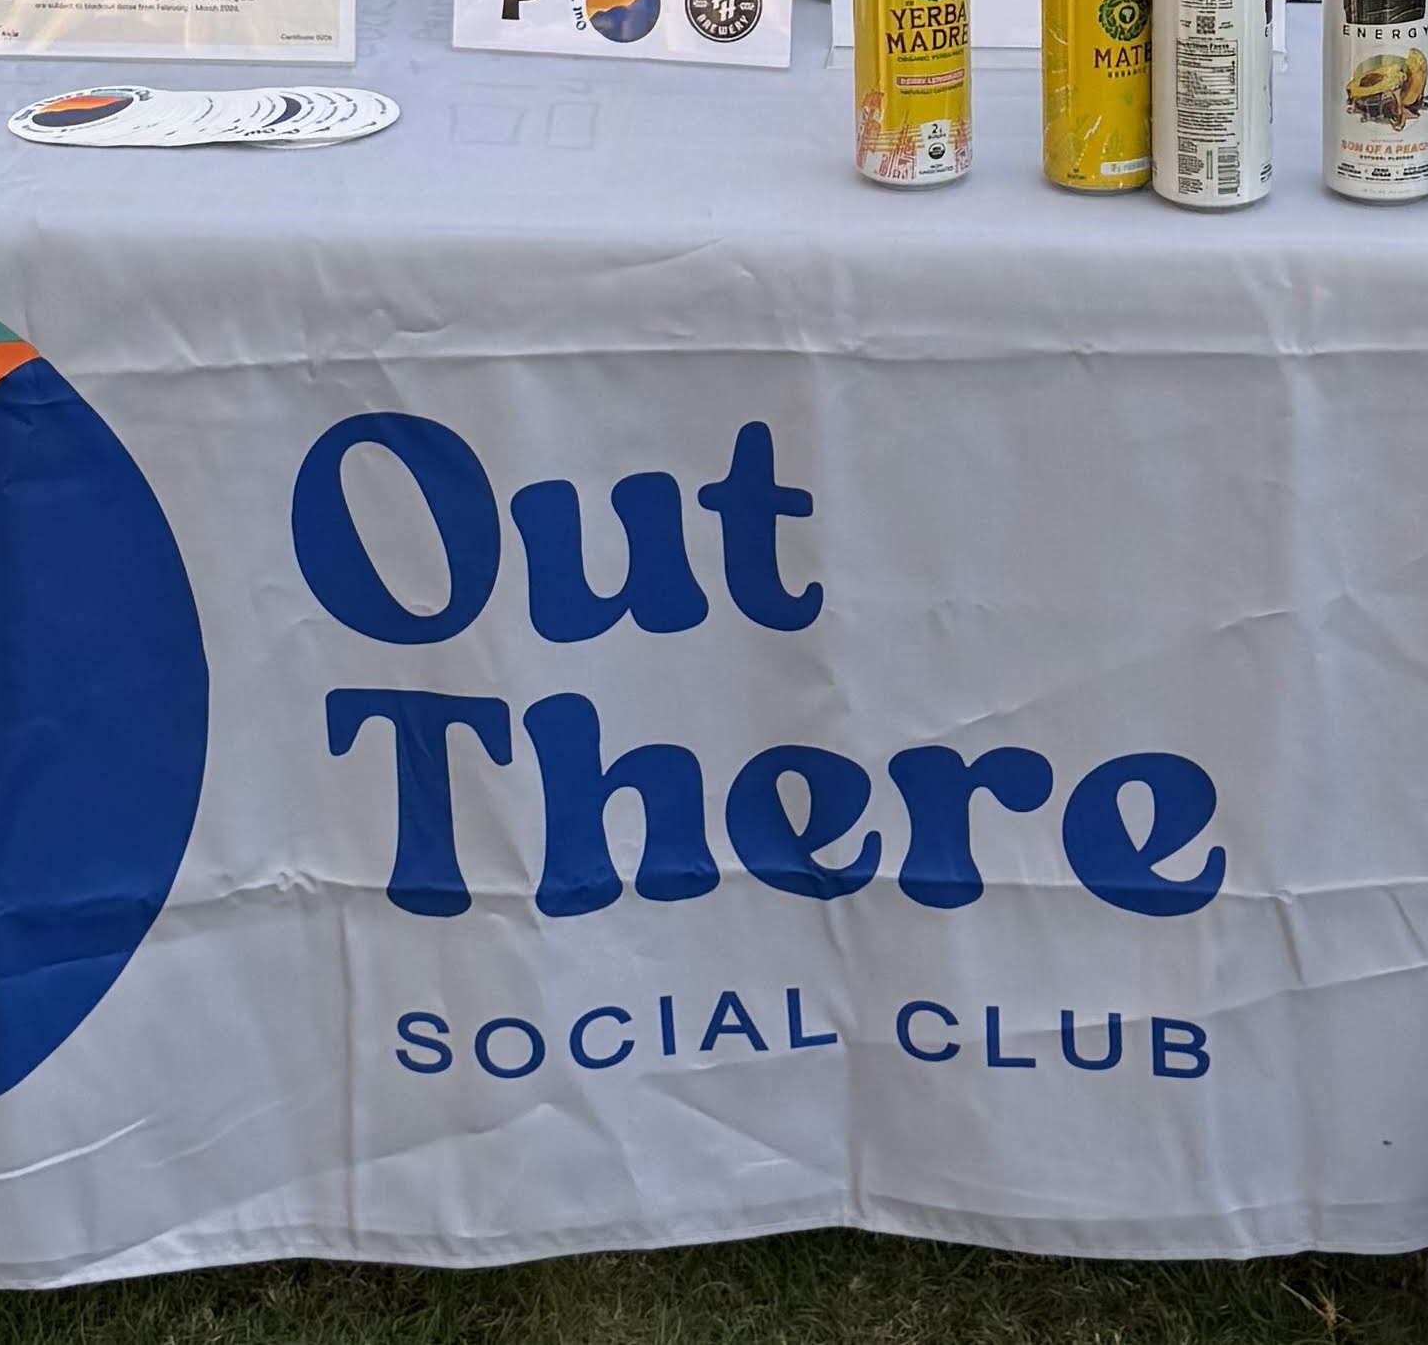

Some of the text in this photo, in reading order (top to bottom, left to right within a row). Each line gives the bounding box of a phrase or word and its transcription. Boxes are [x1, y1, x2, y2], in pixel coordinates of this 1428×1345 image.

[575, 8, 586, 31] Out
[889, 1, 968, 30] YERBA
[885, 24, 969, 55] MADRE
[1366, 143, 1381, 154] OF
[1385, 145, 1392, 154] A
[291, 411, 823, 644] Out
[325, 687, 1226, 917] There
[395, 987, 1212, 1079] SOCIAL CLUB
